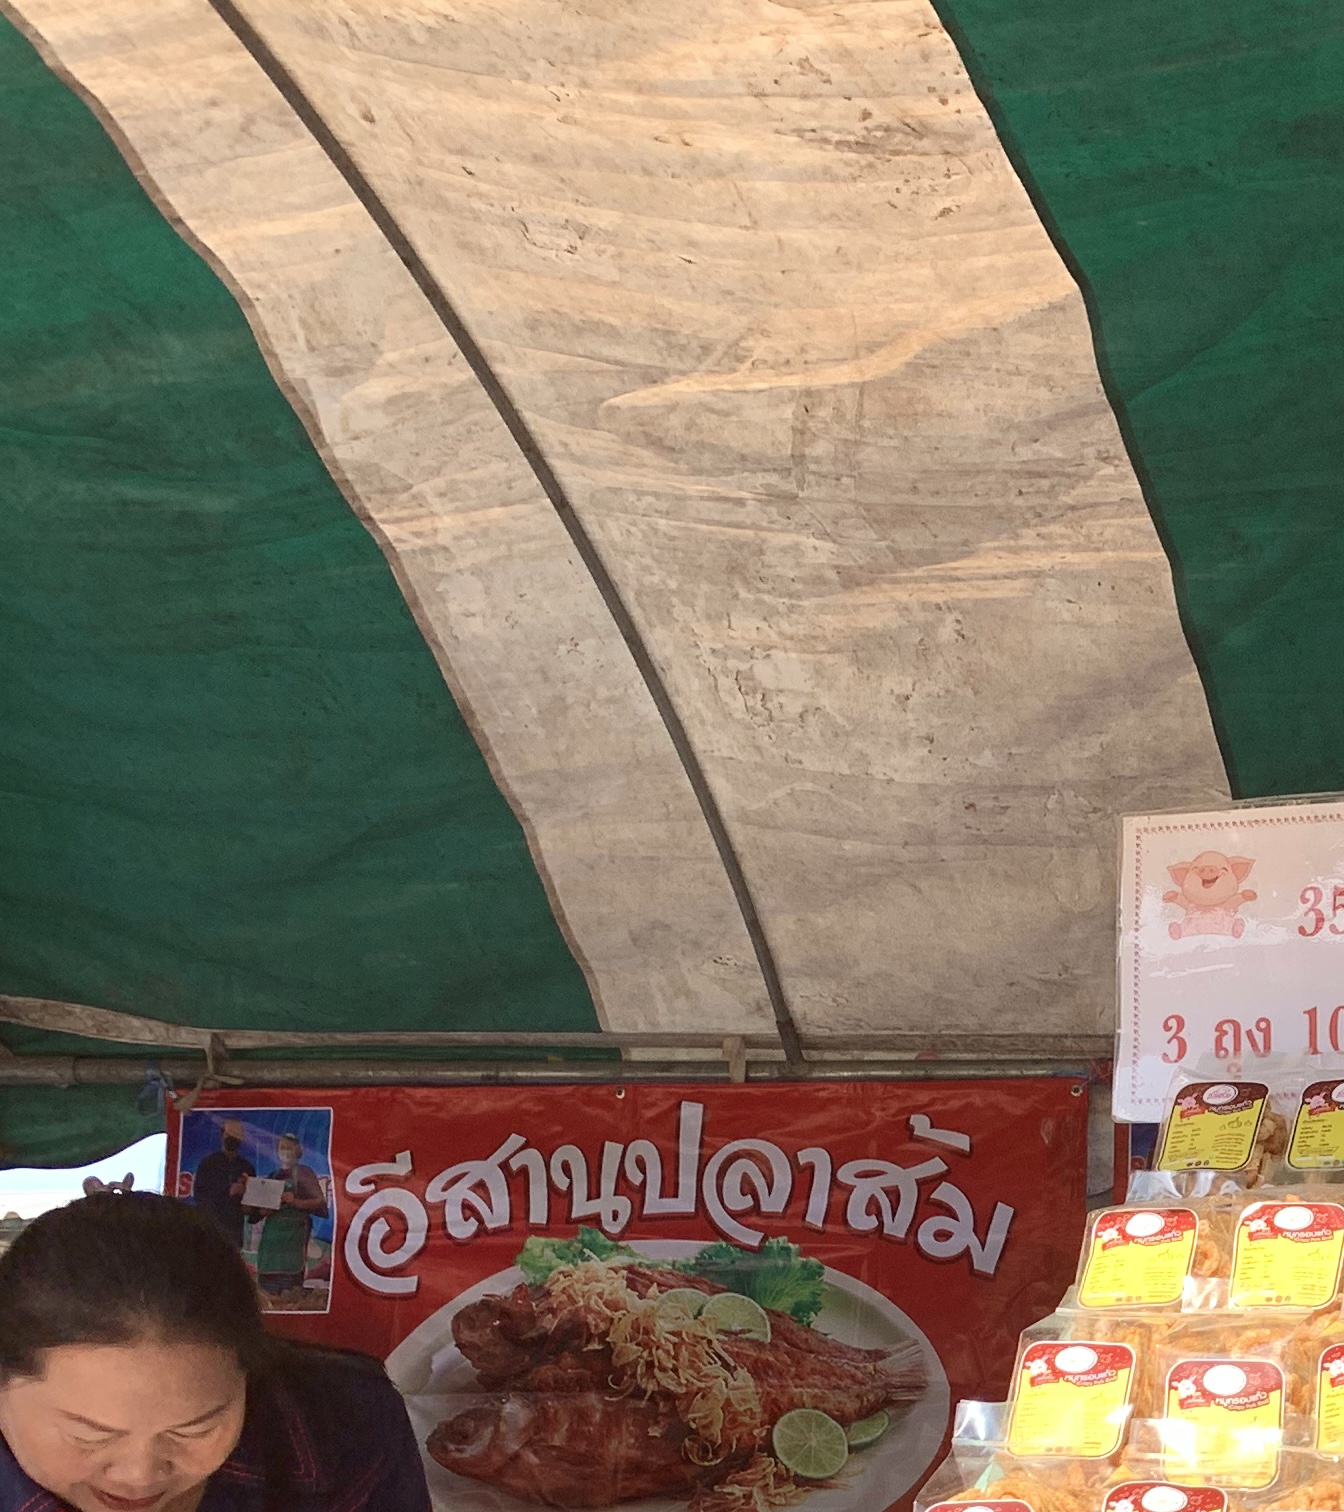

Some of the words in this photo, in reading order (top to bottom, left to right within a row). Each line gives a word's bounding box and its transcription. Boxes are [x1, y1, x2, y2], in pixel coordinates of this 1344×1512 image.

[1161, 1014, 1188, 1064] 3
[343, 1100, 1015, 1294] อีสานปลาส้ม
